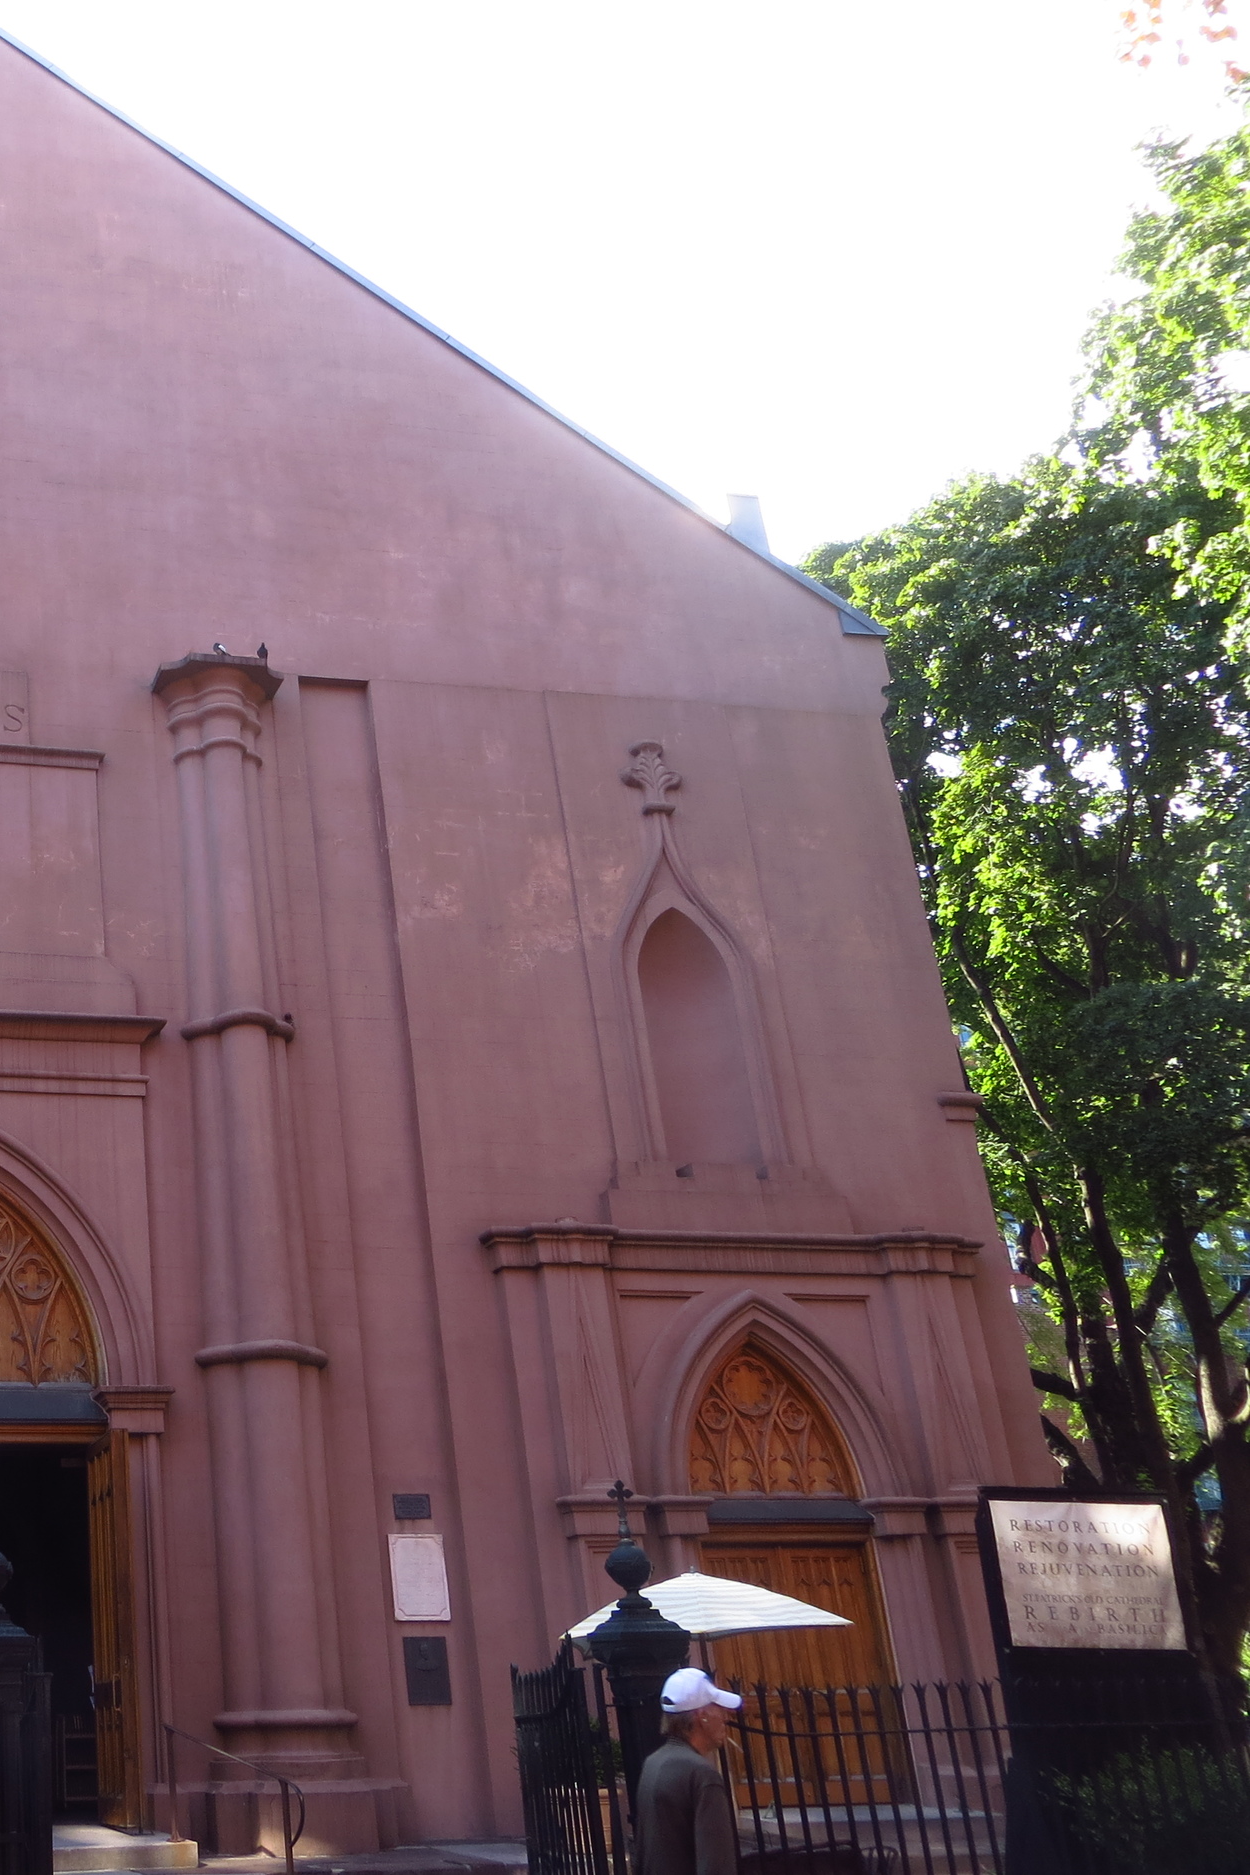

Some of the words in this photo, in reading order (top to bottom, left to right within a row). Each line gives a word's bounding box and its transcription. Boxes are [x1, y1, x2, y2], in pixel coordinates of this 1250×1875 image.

[1009, 1519, 1151, 1534] RESTORATION
[1012, 1540, 1156, 1556] RENOVATION
[1016, 1562, 1160, 1577] REJUVENATION
[1106, 1595, 1163, 1606] CATHEDRAL
[1023, 1605, 1166, 1623] REBIRTH
[1026, 1622, 1045, 1633] AS
[1068, 1624, 1078, 1634] A
[1097, 1623, 1168, 1636] BASILICA
